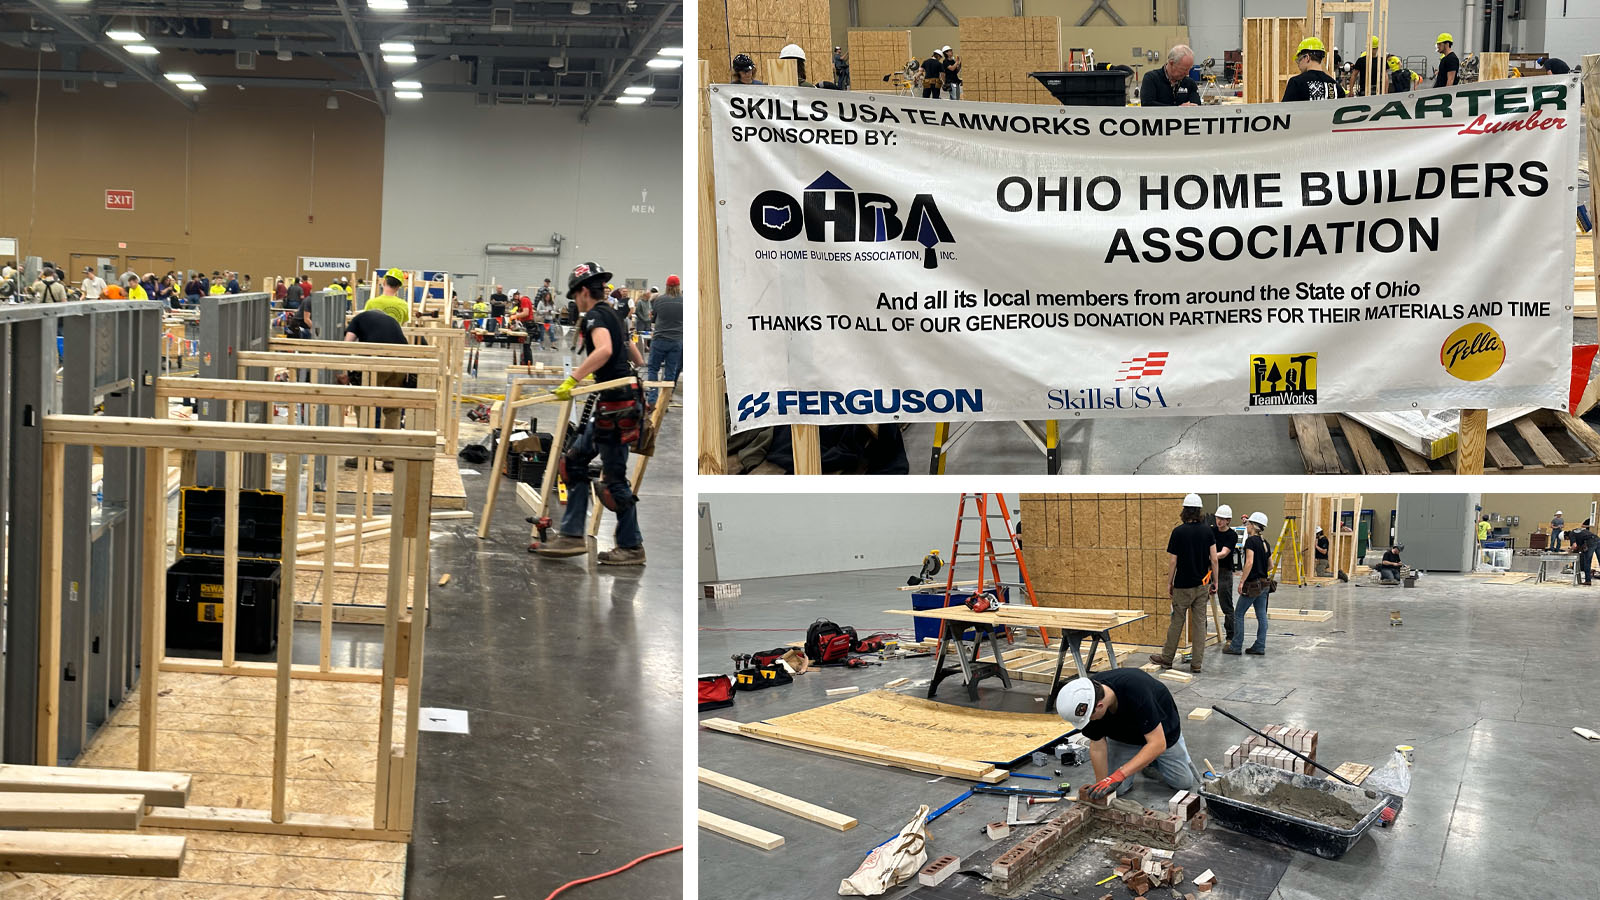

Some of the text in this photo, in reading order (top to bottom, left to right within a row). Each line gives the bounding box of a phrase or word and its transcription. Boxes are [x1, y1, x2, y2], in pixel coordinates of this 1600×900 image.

[729, 97, 1291, 136] SKILLS USA TEAMWORKS COMPETITION
[1332, 84, 1567, 125] CARTER
[731, 126, 897, 146] SPONSORED BY:
[1457, 109, 1567, 136] Lumber
[107, 194, 132, 205] EXIT
[996, 160, 1549, 212] OHIO HOME BUILDERS
[631, 204, 655, 214] MEN
[750, 186, 957, 245] OHBA
[1104, 217, 1439, 263] ASSOCIATION
[309, 261, 351, 269] PLUMBING
[755, 250, 958, 262] OHIO HOME BUILDERS ASSOCIATION, INC.
[876, 281, 1420, 310] And all its local members from around the State of Ohio
[748, 301, 1551, 332] THANKS TO ALL OF OUR GENEROUS DONATION PARTNERS FOR THEIR MATERIALS AND TIME
[1446, 332, 1499, 368] Pella
[777, 388, 983, 415] FERGUSON
[1047, 386, 1170, 409] SkillsUSA
[1252, 391, 1315, 406] TeamWorks
